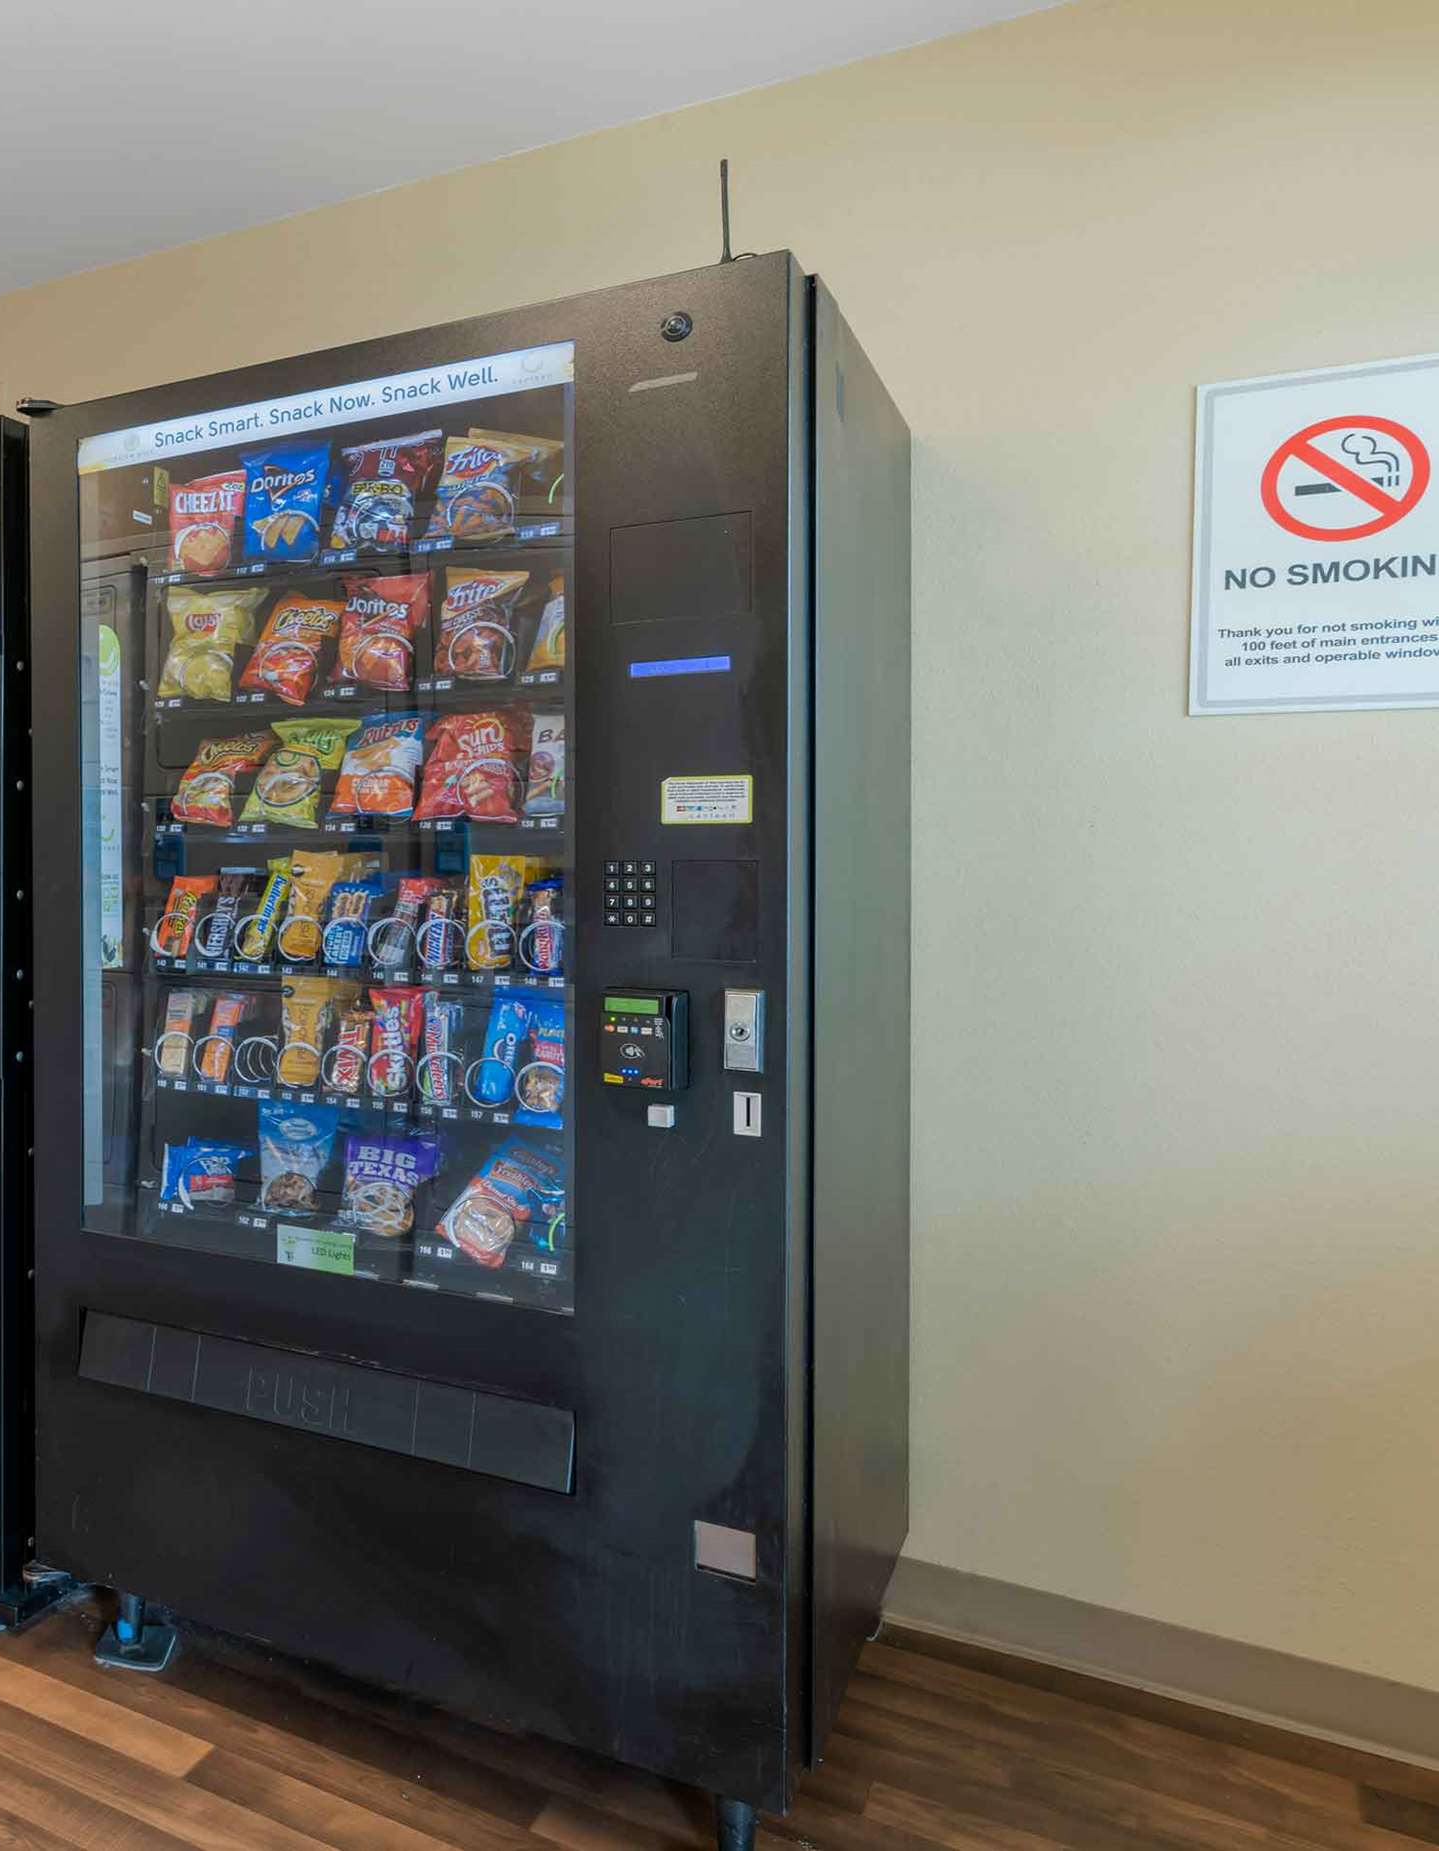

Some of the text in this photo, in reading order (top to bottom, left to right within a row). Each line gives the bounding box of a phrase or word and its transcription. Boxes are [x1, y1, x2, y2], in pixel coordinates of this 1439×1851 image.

[154, 424, 203, 447] Snack
[208, 412, 263, 437] Smart.
[270, 400, 323, 424] Snack
[329, 393, 375, 413] Now.
[382, 377, 440, 403] Snack
[448, 366, 498, 391] Well.
[251, 469, 316, 494] Doritos
[1224, 554, 1436, 590] NO SMOKIN
[346, 597, 409, 619] Doritos
[1217, 628, 1262, 639] Thank
[1266, 627, 1293, 638] you
[1297, 624, 1318, 634] for
[1322, 622, 1346, 633] not
[1350, 617, 1417, 631] smoking
[1242, 633, 1438, 652] 100 feet of main entrances
[1224, 657, 1241, 667] all
[1245, 655, 1279, 666] exits
[1282, 653, 1310, 664] and
[1315, 650, 1381, 664] operable
[472, 975, 484, 984] 147
[358, 1146, 417, 1169] BIG
[349, 1161, 420, 1187] TEXAS
[246, 1366, 352, 1431] PUSH
